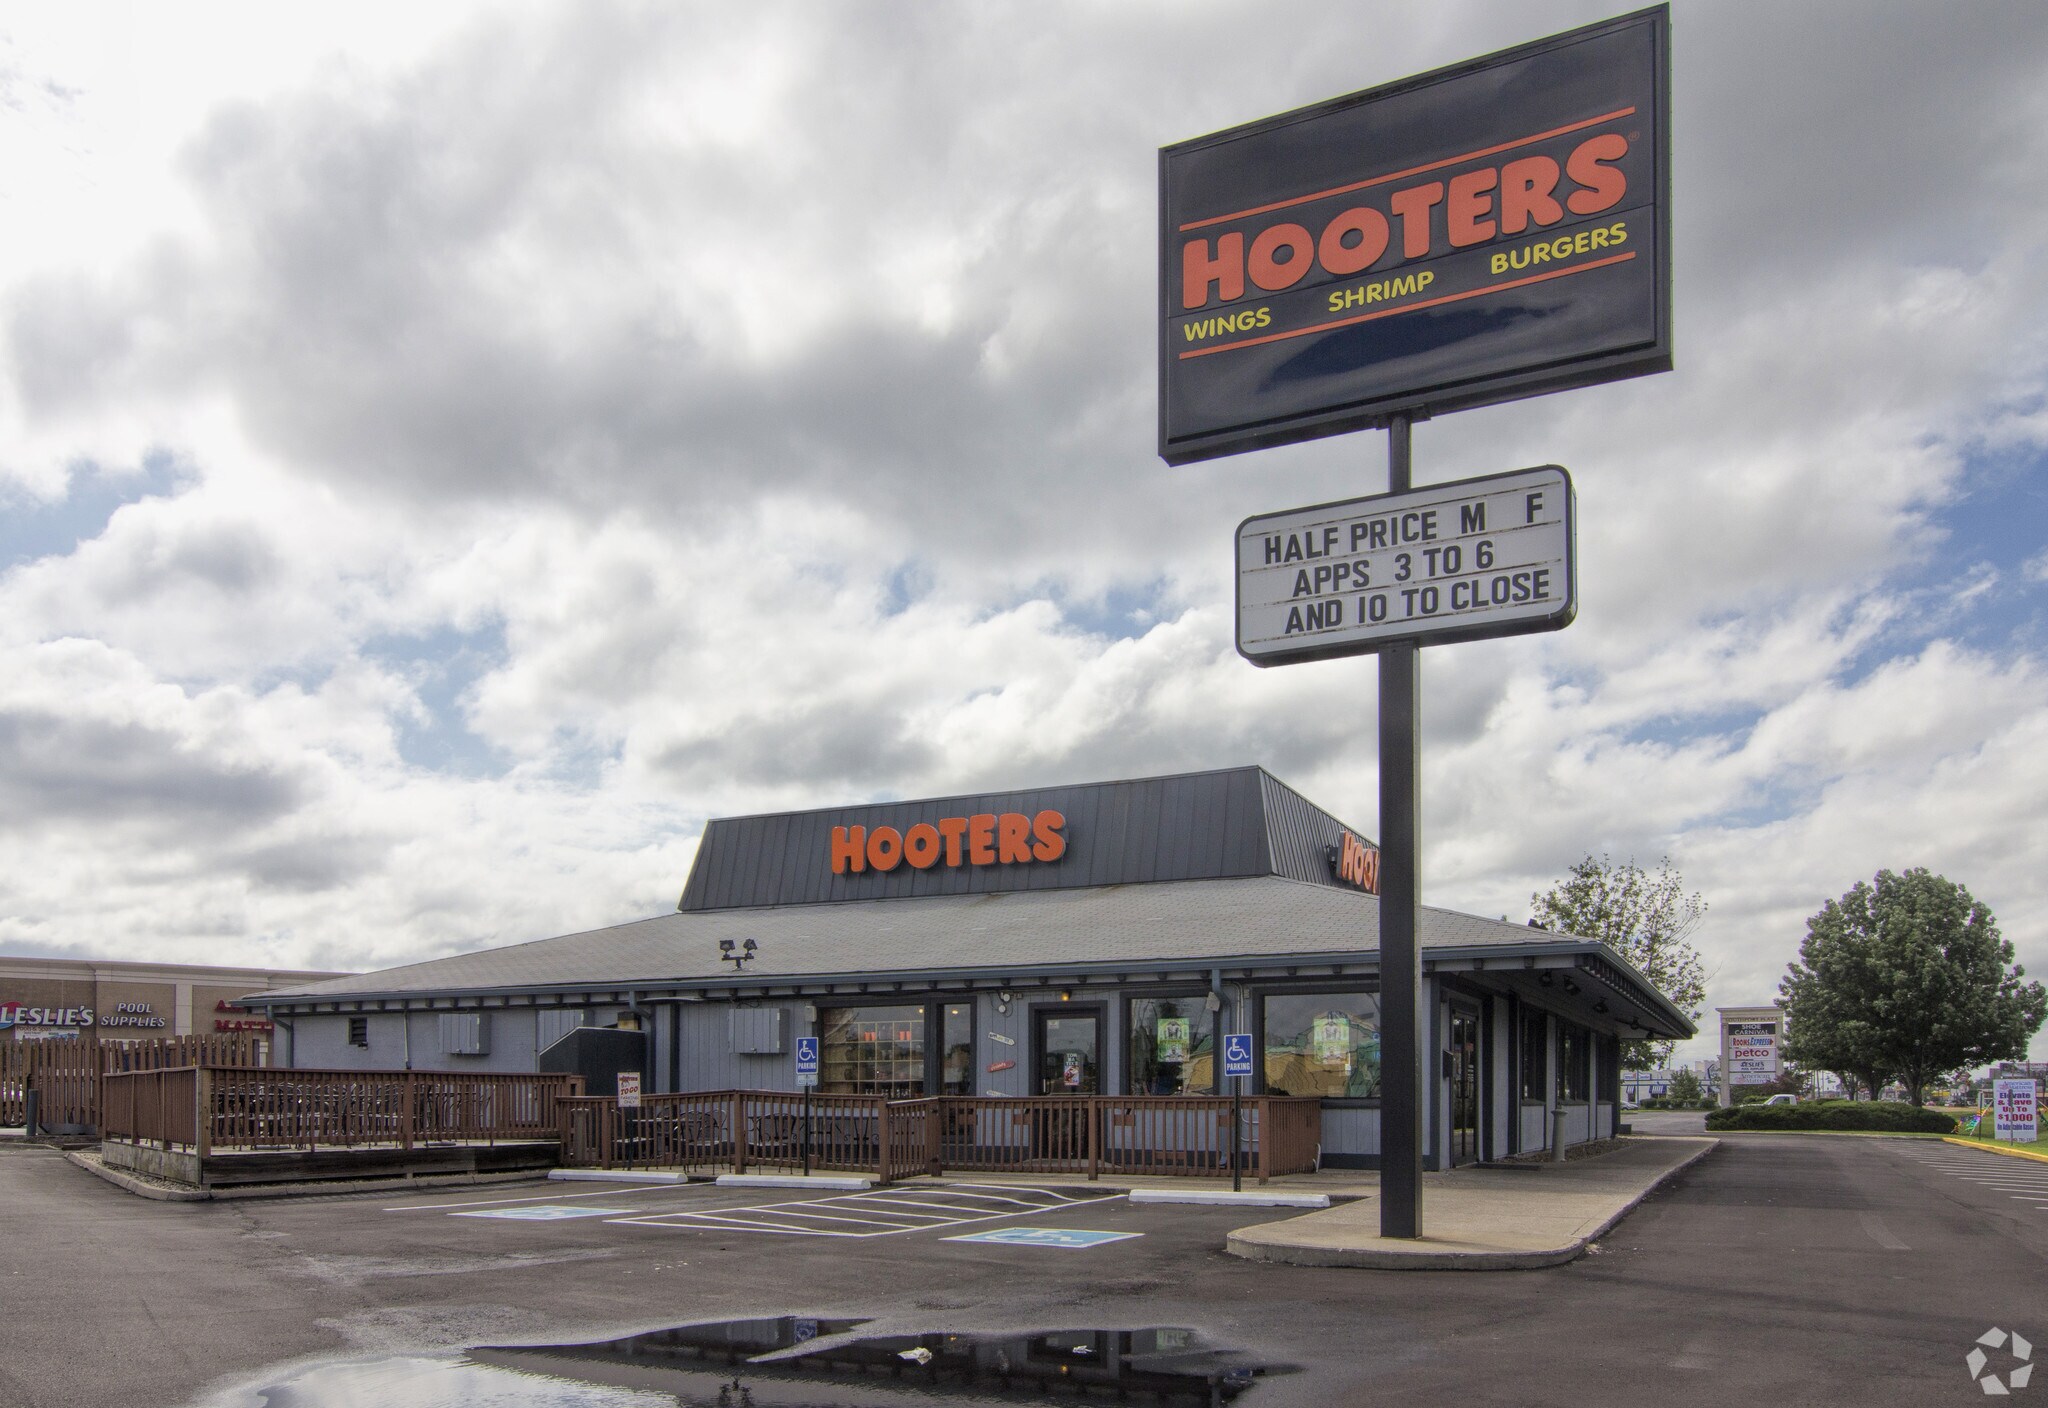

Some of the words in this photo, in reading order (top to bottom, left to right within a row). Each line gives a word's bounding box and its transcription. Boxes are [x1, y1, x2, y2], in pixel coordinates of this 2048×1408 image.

[1182, 133, 1630, 310] HOOTERS
[1183, 306, 1272, 343] WINGS
[1327, 271, 1435, 313] SHRIMP
[1490, 222, 1628, 275] BURGERS
[1264, 526, 1338, 565] HALF
[1350, 510, 1437, 552] PRICE
[1460, 502, 1486, 534] M
[1526, 492, 1543, 523] F
[1292, 559, 1370, 597] APPS
[1394, 553, 1411, 582] 3
[1423, 545, 1461, 577] TO
[1476, 540, 1494, 570] 6
[1284, 599, 1343, 635] AND
[1401, 586, 1438, 617] TO
[1451, 569, 1550, 610] CLOSE
[831, 810, 1067, 875] HOOTERS
[0, 1005, 94, 1026] LESLIE'S
[100, 1015, 166, 1028] SUPPLIES
[117, 1002, 153, 1013] POOL
[798, 1062, 817, 1070] PARKING
[1226, 1063, 1251, 1072] PARKING
[1735, 1048, 1769, 1058] petco
